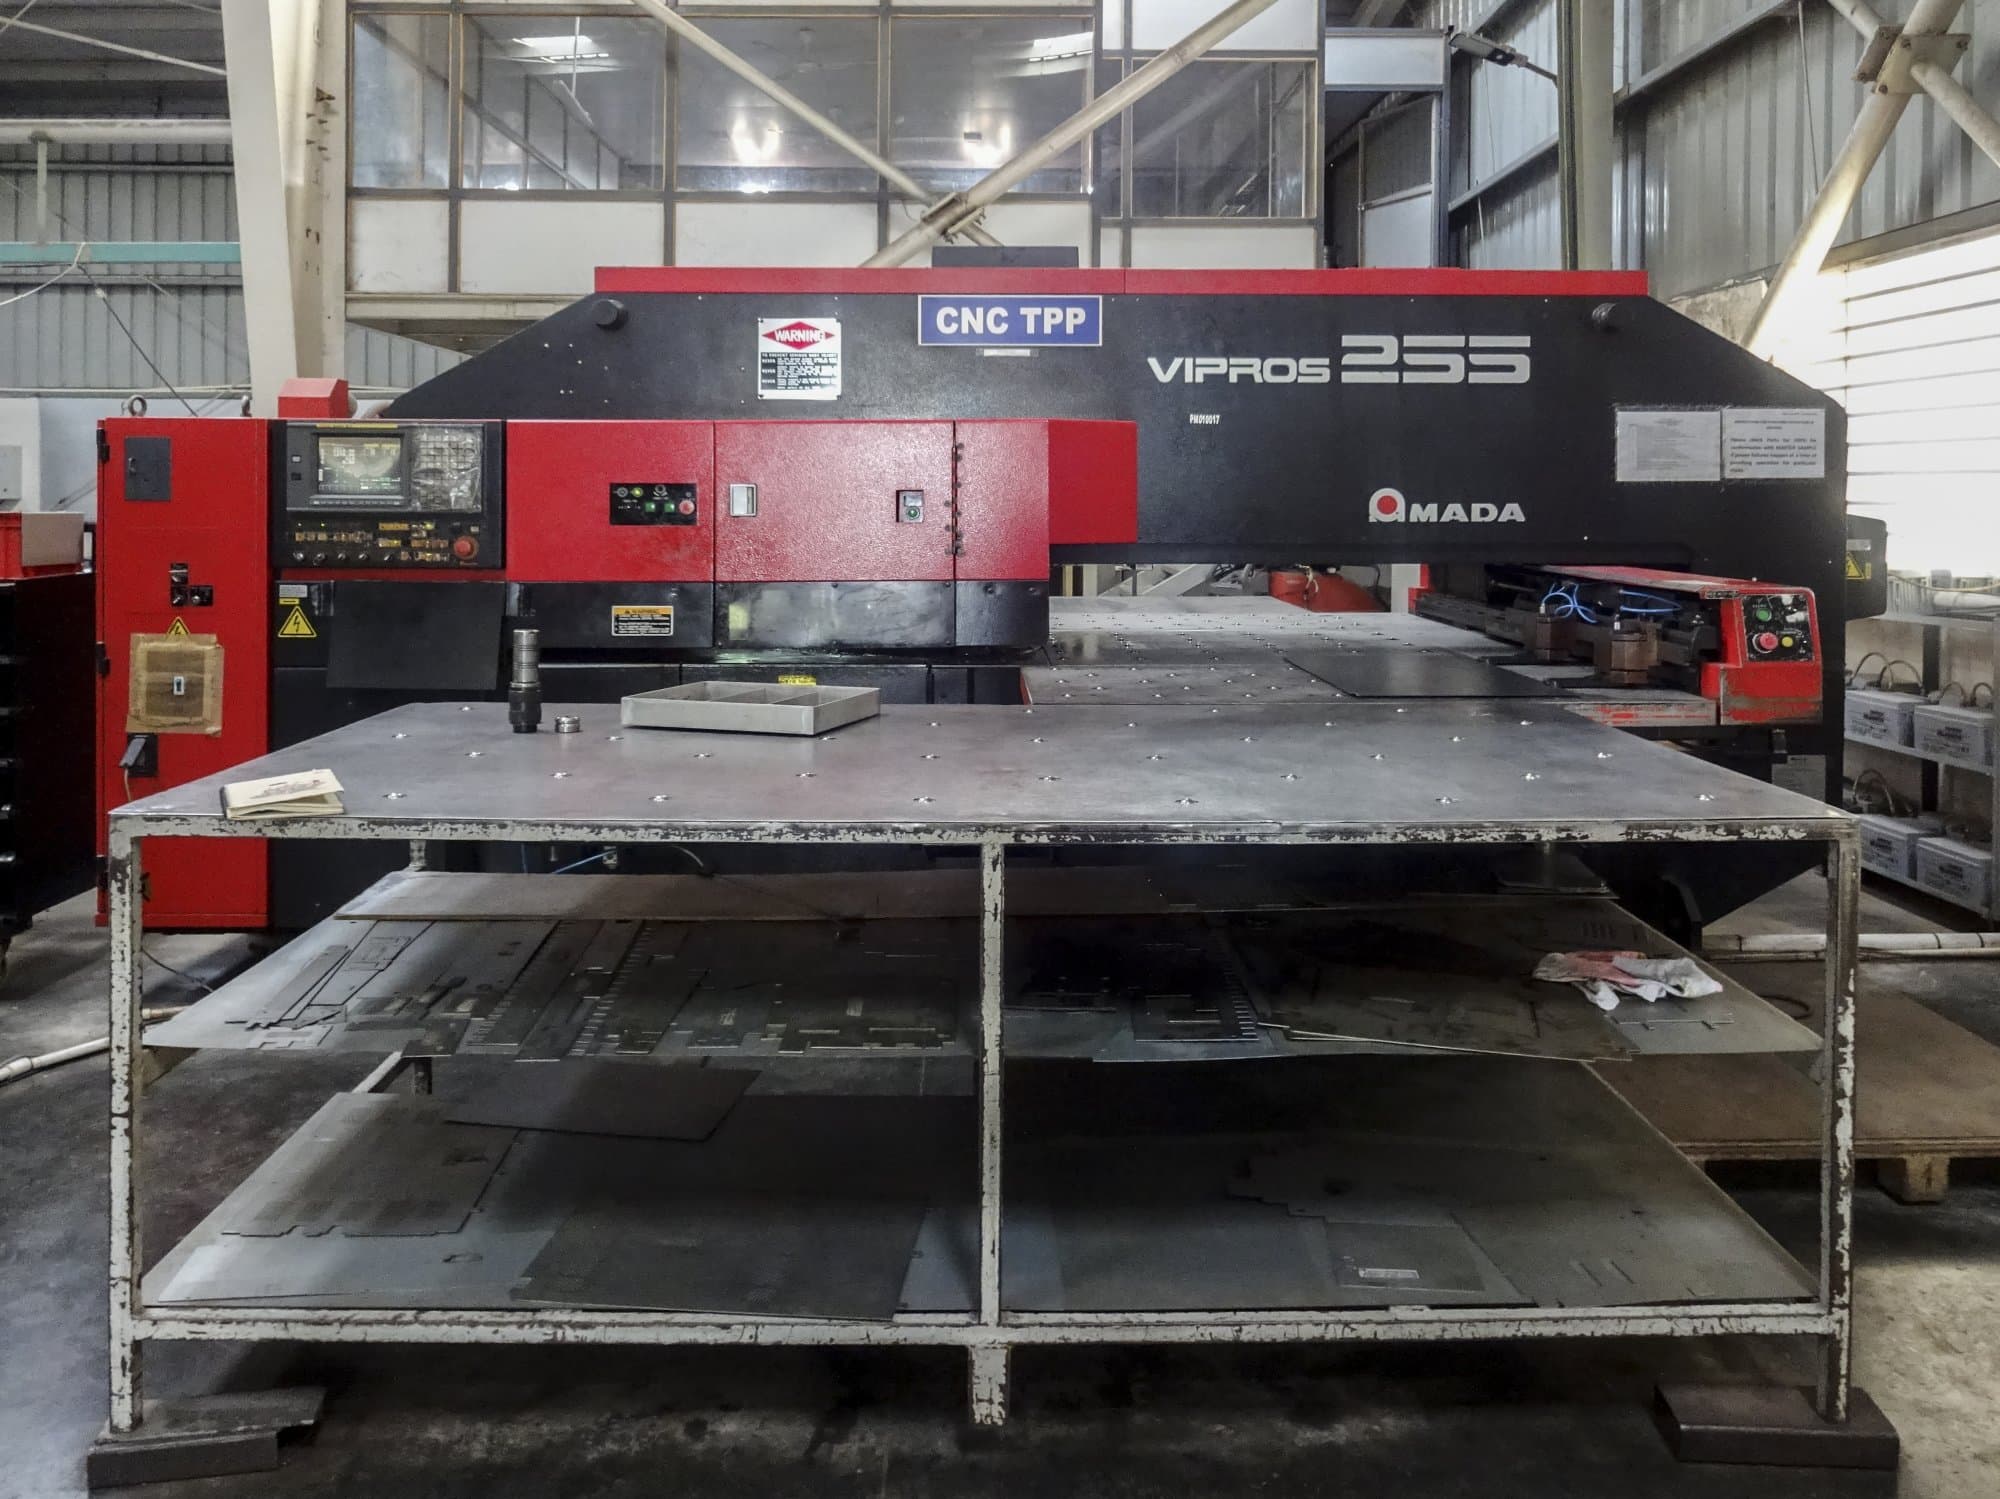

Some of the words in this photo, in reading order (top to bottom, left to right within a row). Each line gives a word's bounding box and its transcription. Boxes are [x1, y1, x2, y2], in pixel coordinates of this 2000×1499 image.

[775, 329, 825, 343] WARNING
[936, 306, 1009, 334] CNC
[1020, 306, 1087, 334] TPP
[1146, 357, 1330, 384] VIPROS
[1341, 335, 1531, 384] 255
[1368, 487, 1527, 523] AMADA
